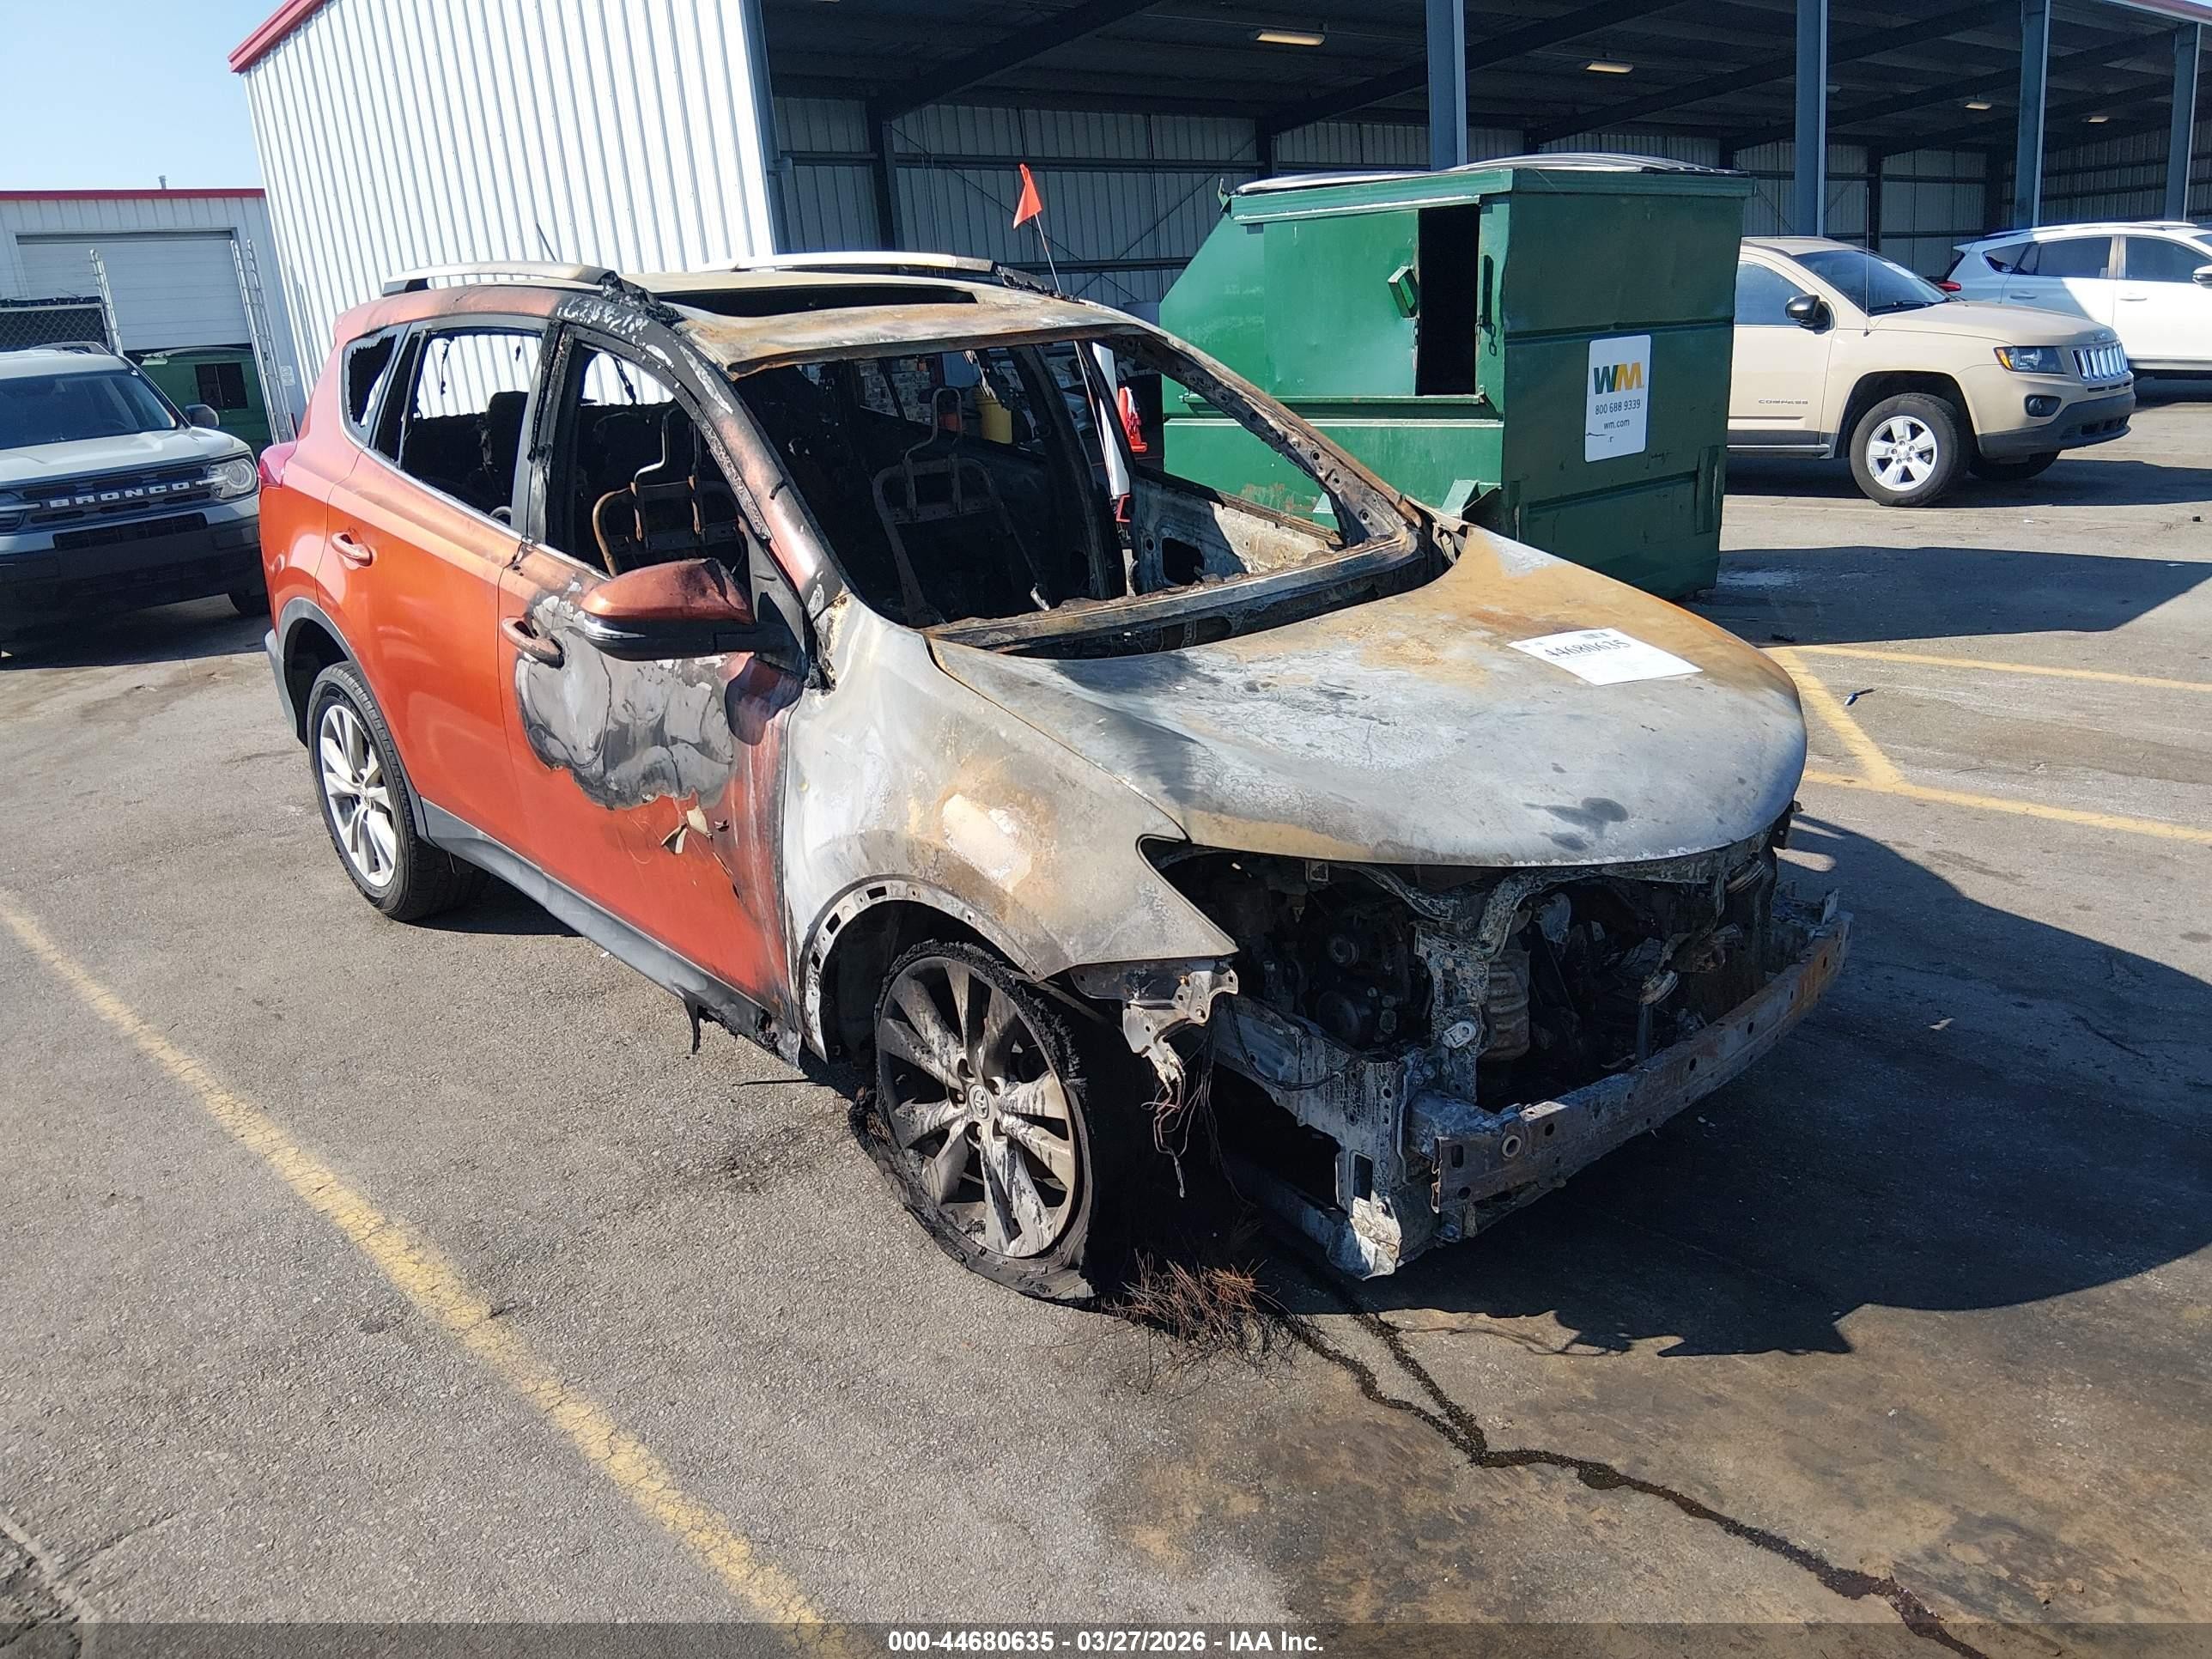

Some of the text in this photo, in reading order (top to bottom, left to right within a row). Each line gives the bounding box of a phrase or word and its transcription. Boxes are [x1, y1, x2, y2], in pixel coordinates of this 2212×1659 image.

[1594, 362, 1642, 395] WM
[1595, 398, 1641, 415] 800 688 9339
[1604, 419, 1630, 429] wm.com
[49, 481, 191, 508] BRONCO
